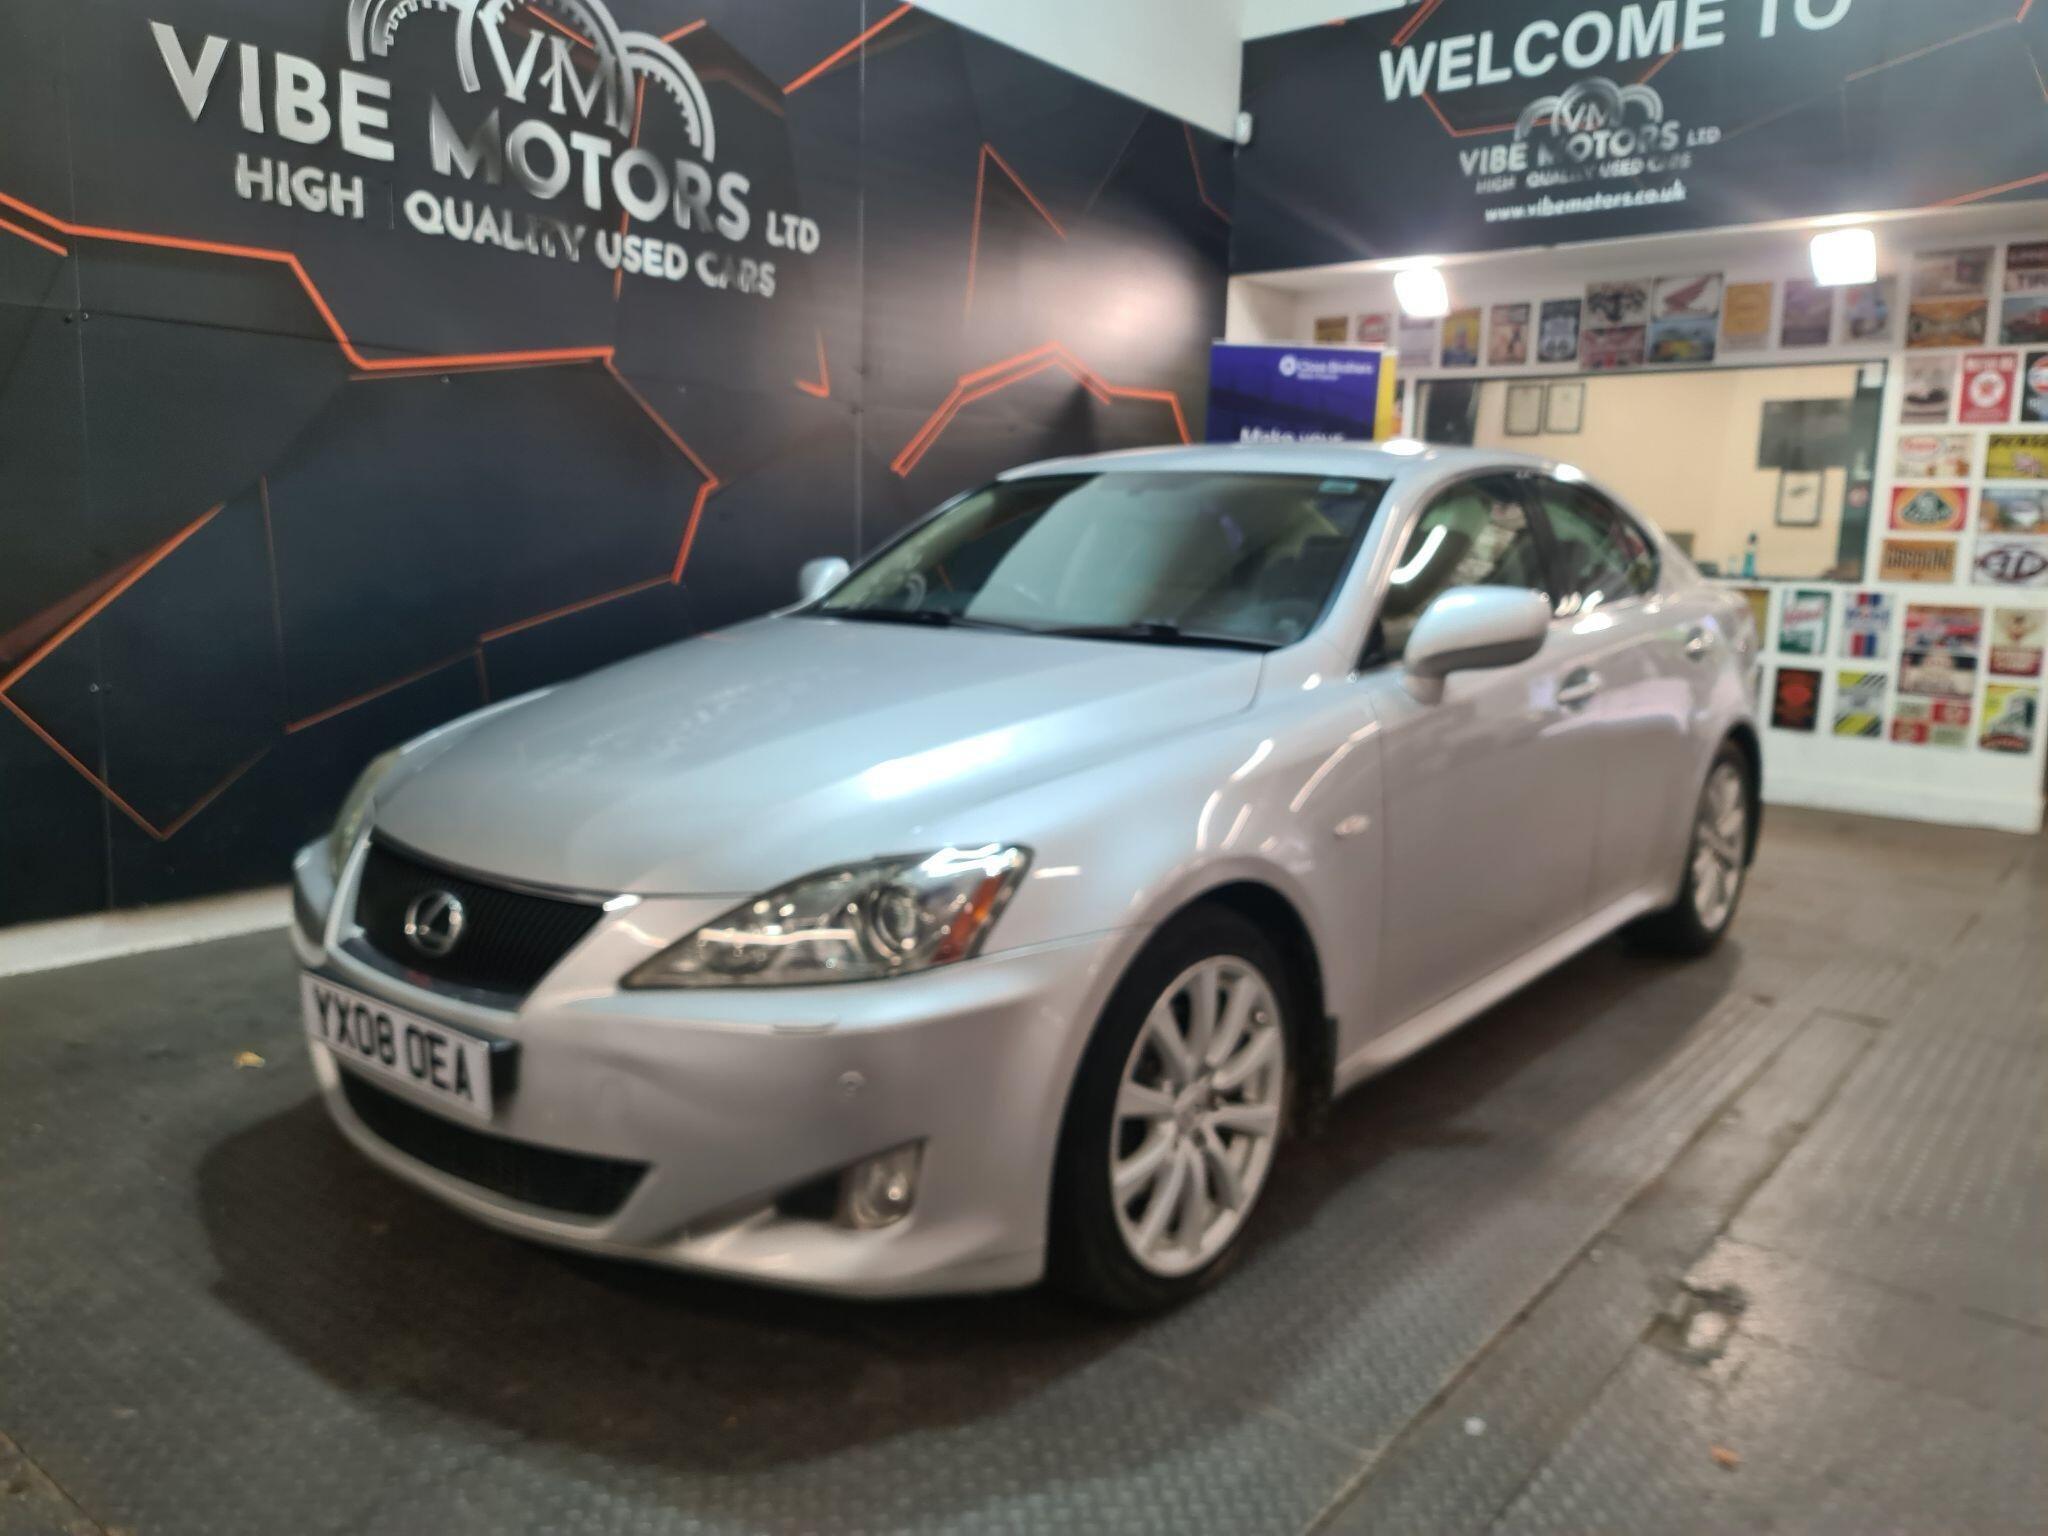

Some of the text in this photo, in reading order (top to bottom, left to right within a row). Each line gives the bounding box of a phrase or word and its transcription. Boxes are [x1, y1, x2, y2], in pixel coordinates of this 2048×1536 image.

[1379, 0, 1726, 103] WELCOME
[149, 19, 821, 253] VIBE MOTORS LTD
[1459, 141, 1529, 177] VIBE
[235, 153, 366, 219] HIGH
[404, 190, 587, 263] QUALITY
[597, 230, 689, 282] USED
[1484, 178, 1687, 223] www.vibemotors.co.uk
[314, 984, 396, 1066] YX08
